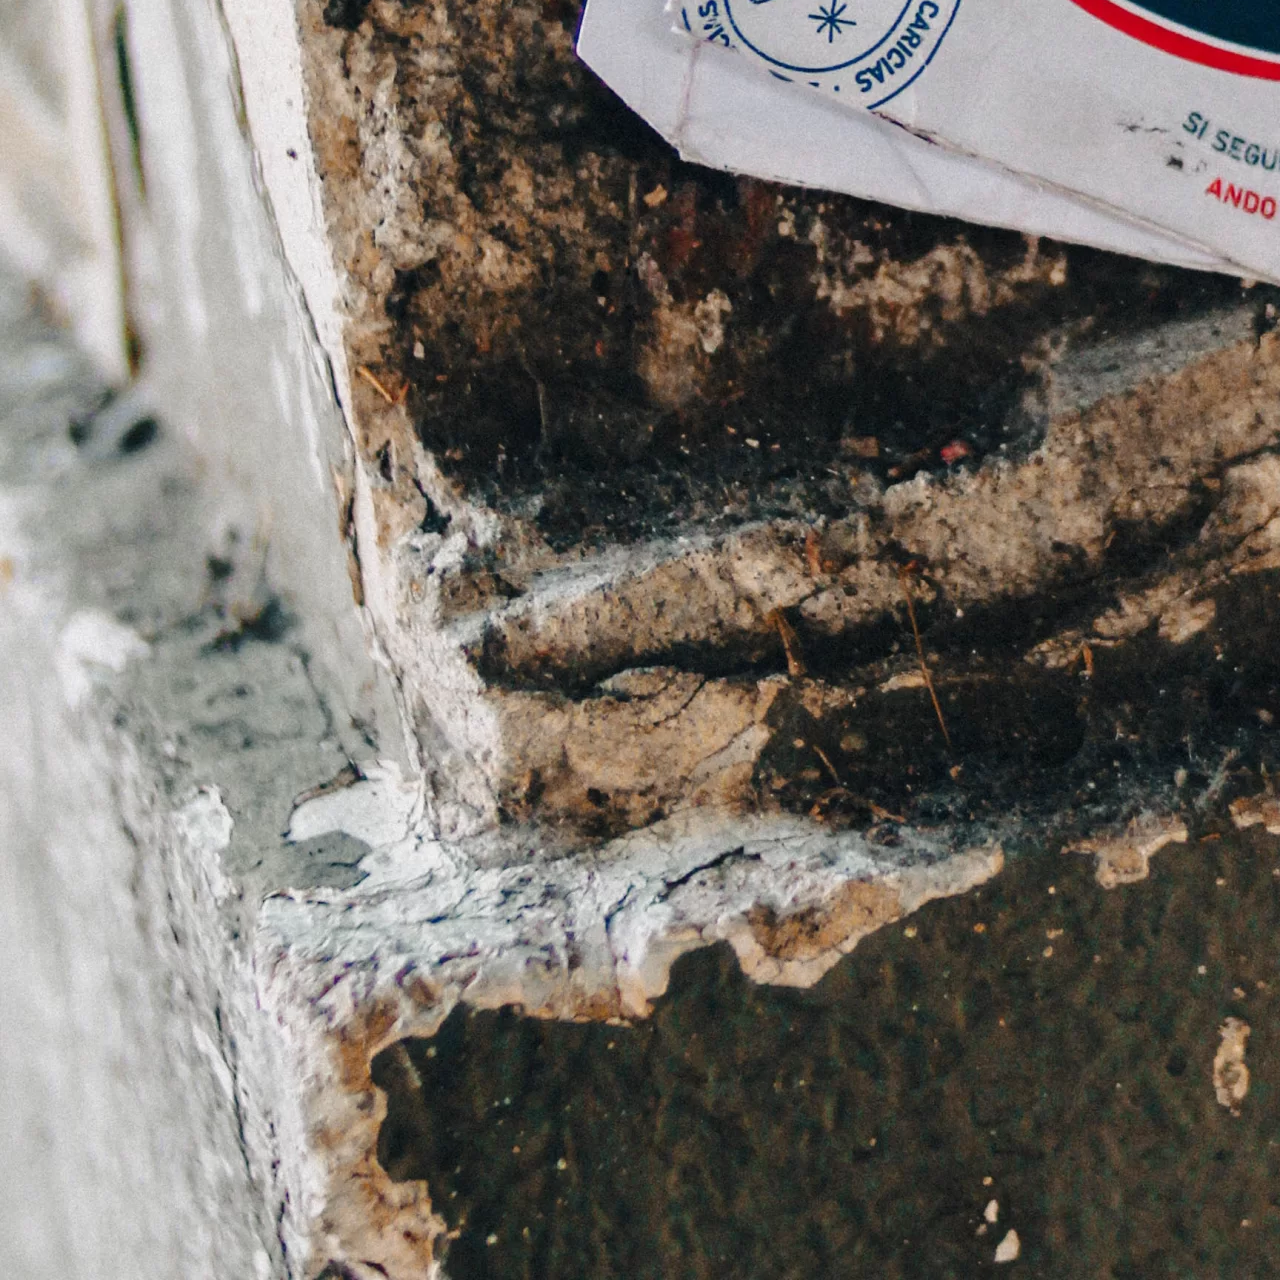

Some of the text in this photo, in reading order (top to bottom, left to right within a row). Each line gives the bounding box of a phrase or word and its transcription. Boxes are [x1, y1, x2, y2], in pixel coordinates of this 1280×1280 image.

[855, 0, 940, 93] CARICIAS
[1182, 111, 1209, 140] SI
[1205, 177, 1277, 220] ANDO
